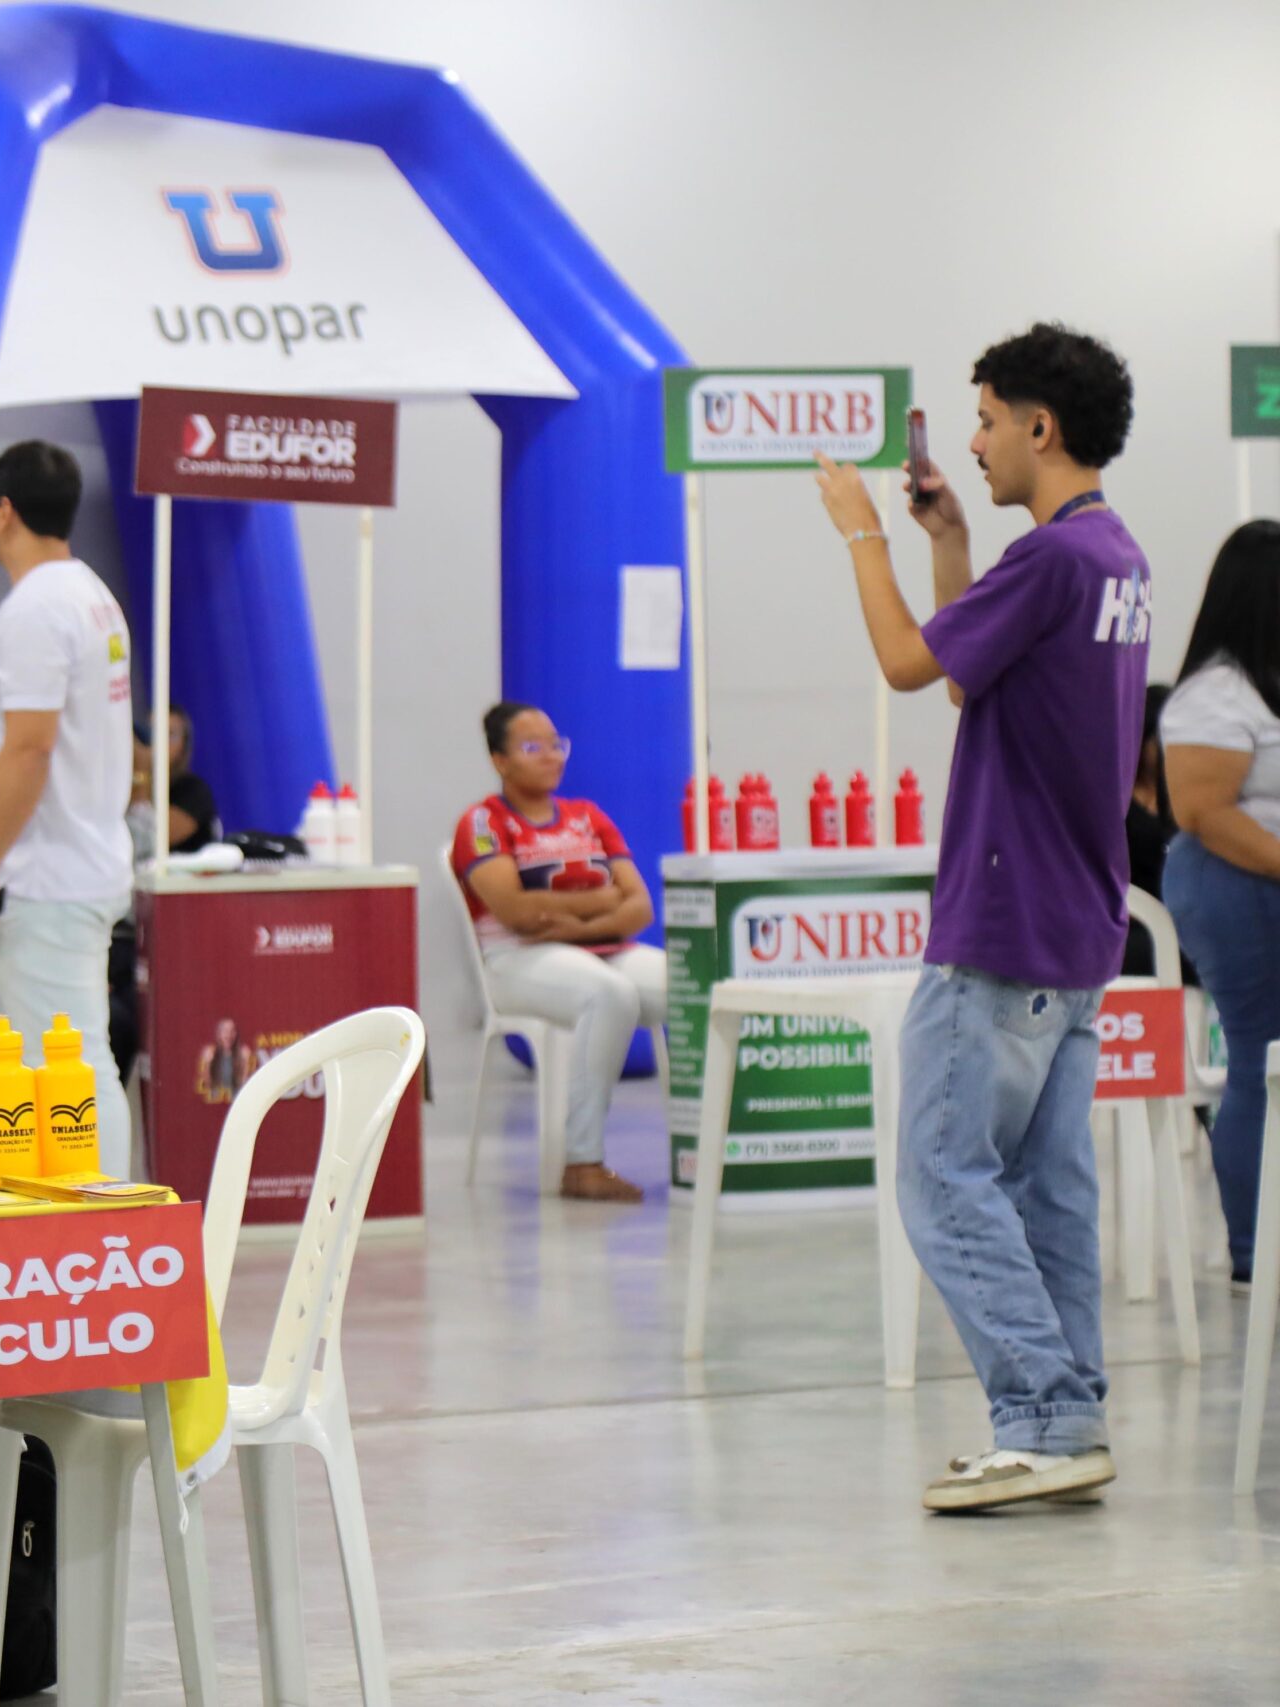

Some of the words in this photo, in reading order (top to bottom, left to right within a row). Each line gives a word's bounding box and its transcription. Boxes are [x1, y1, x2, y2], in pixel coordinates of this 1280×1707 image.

[152, 302, 368, 355] unopar
[226, 413, 357, 438] FACULDADE
[701, 390, 876, 435] UNIRB
[224, 430, 358, 467] EDUFOR
[744, 911, 923, 963] UNIRB
